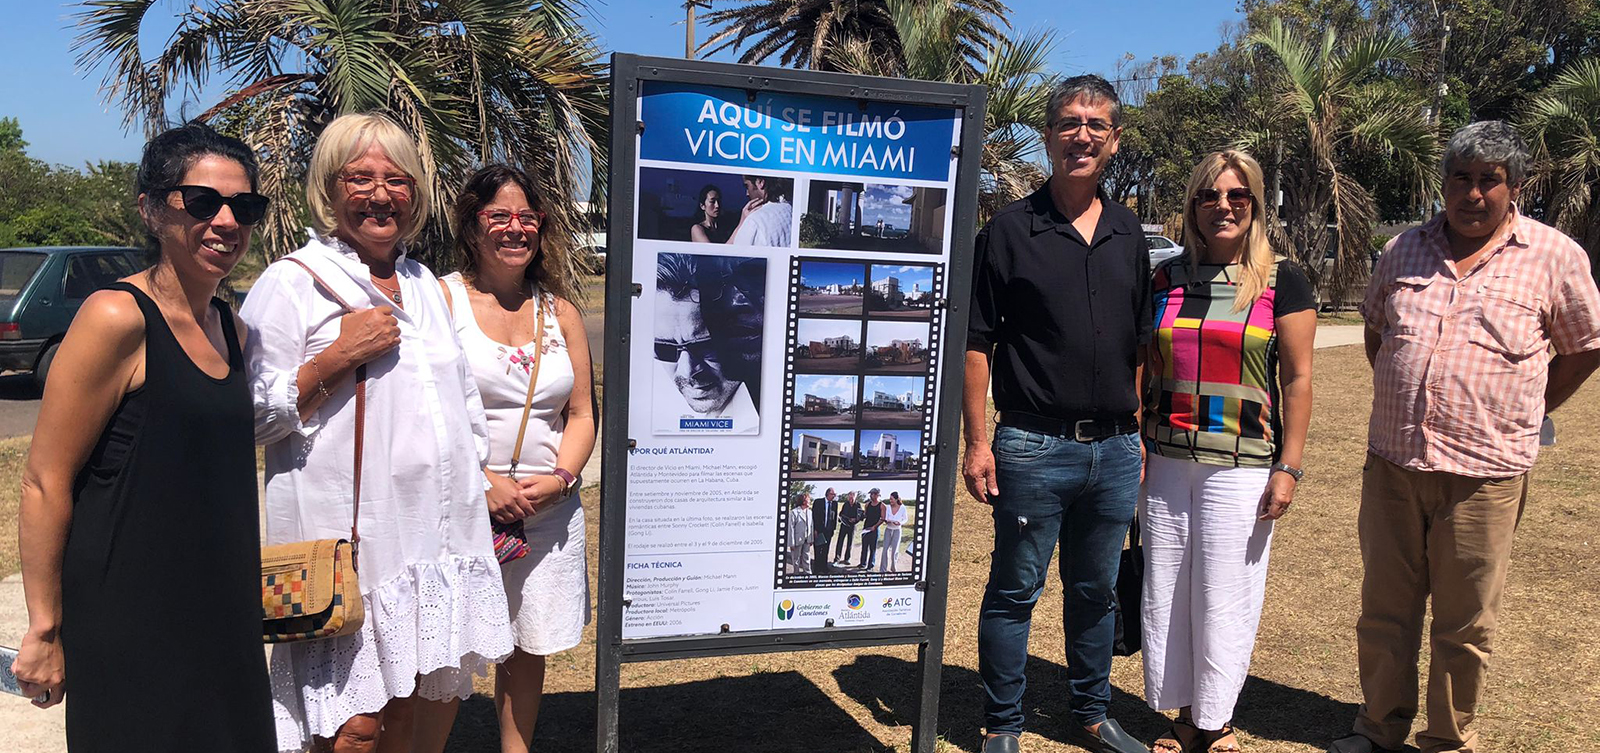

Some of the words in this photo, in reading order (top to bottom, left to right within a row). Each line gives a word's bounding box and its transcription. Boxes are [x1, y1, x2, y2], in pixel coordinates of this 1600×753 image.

[697, 99, 772, 130] AQUÍ
[781, 107, 811, 132] SE
[822, 110, 906, 140] FILMÓ
[684, 128, 770, 162] VICIO
[780, 138, 816, 166] EN
[822, 141, 914, 173] MIAMI
[652, 446, 667, 455] QUÉ
[669, 446, 714, 454] ATLÁNTIDA?
[894, 597, 912, 606] ATC
[839, 610, 870, 619] Atlántida
